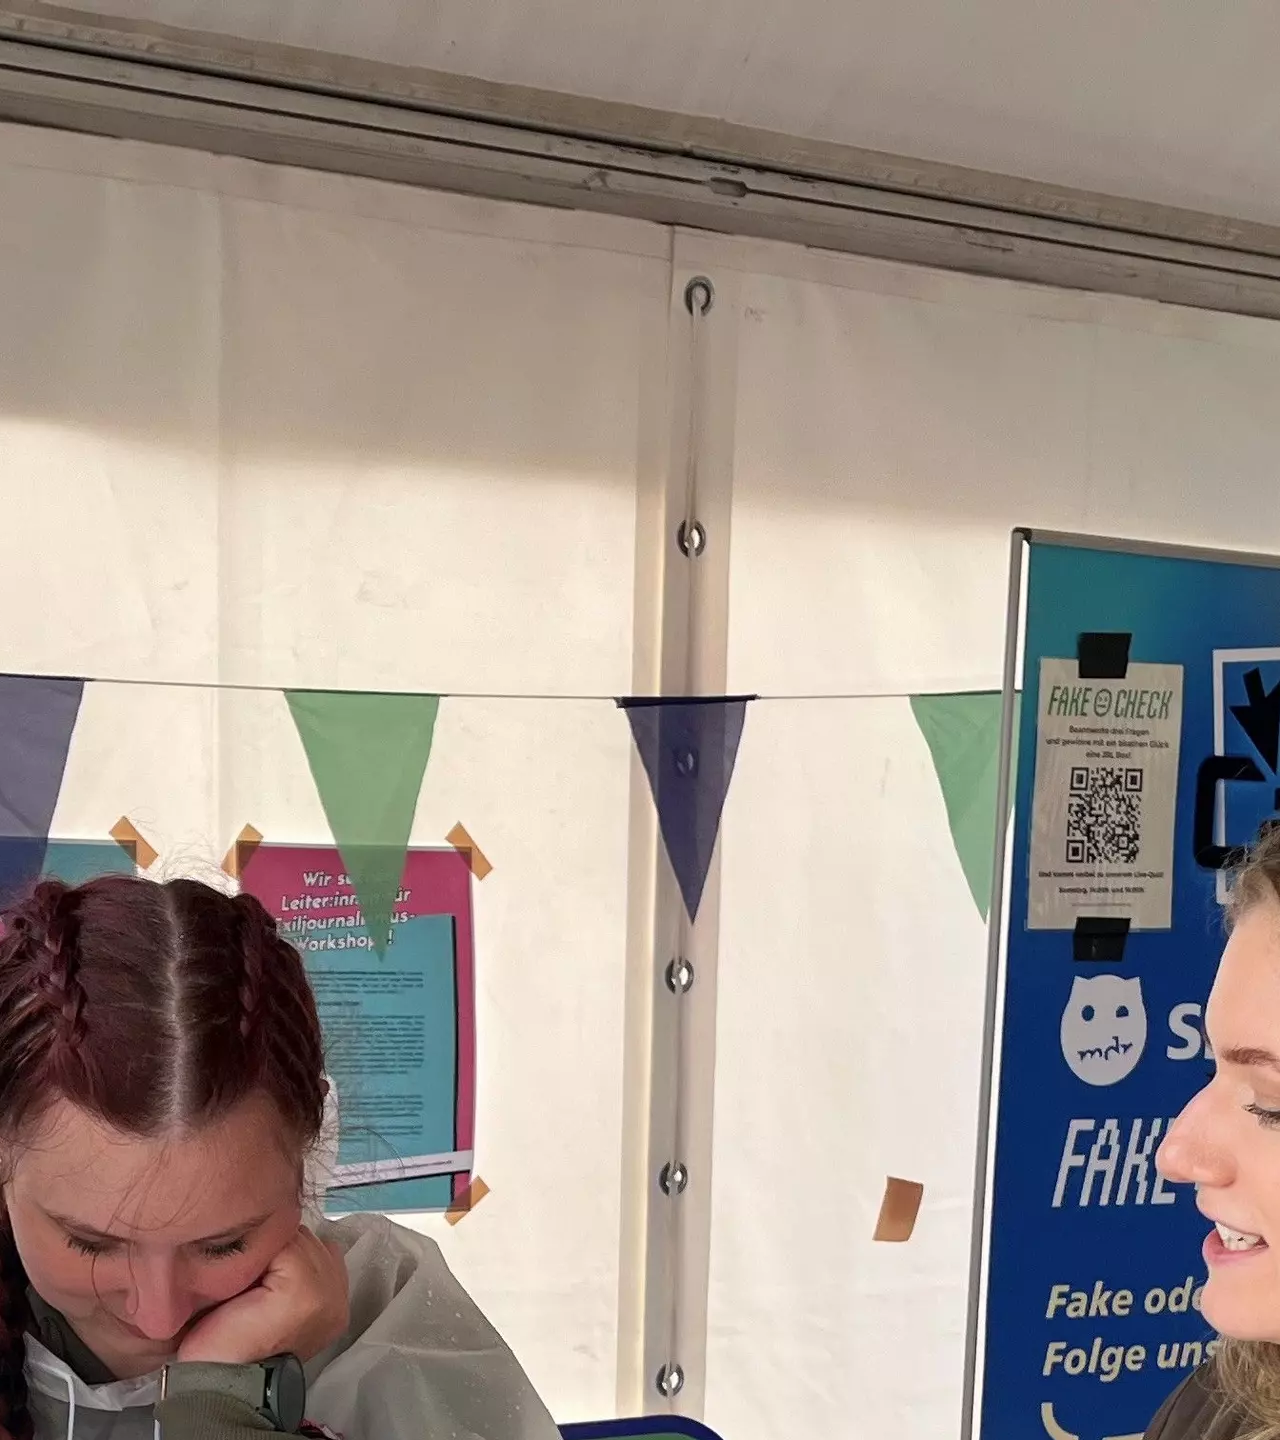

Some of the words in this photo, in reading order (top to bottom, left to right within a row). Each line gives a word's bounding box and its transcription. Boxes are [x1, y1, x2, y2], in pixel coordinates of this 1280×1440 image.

[1047, 685, 1093, 717] FAKE
[1114, 689, 1174, 720] CHECK
[303, 871, 332, 888] Wir
[1045, 1281, 1133, 1319] Fake
[1042, 1337, 1147, 1383] Folge
